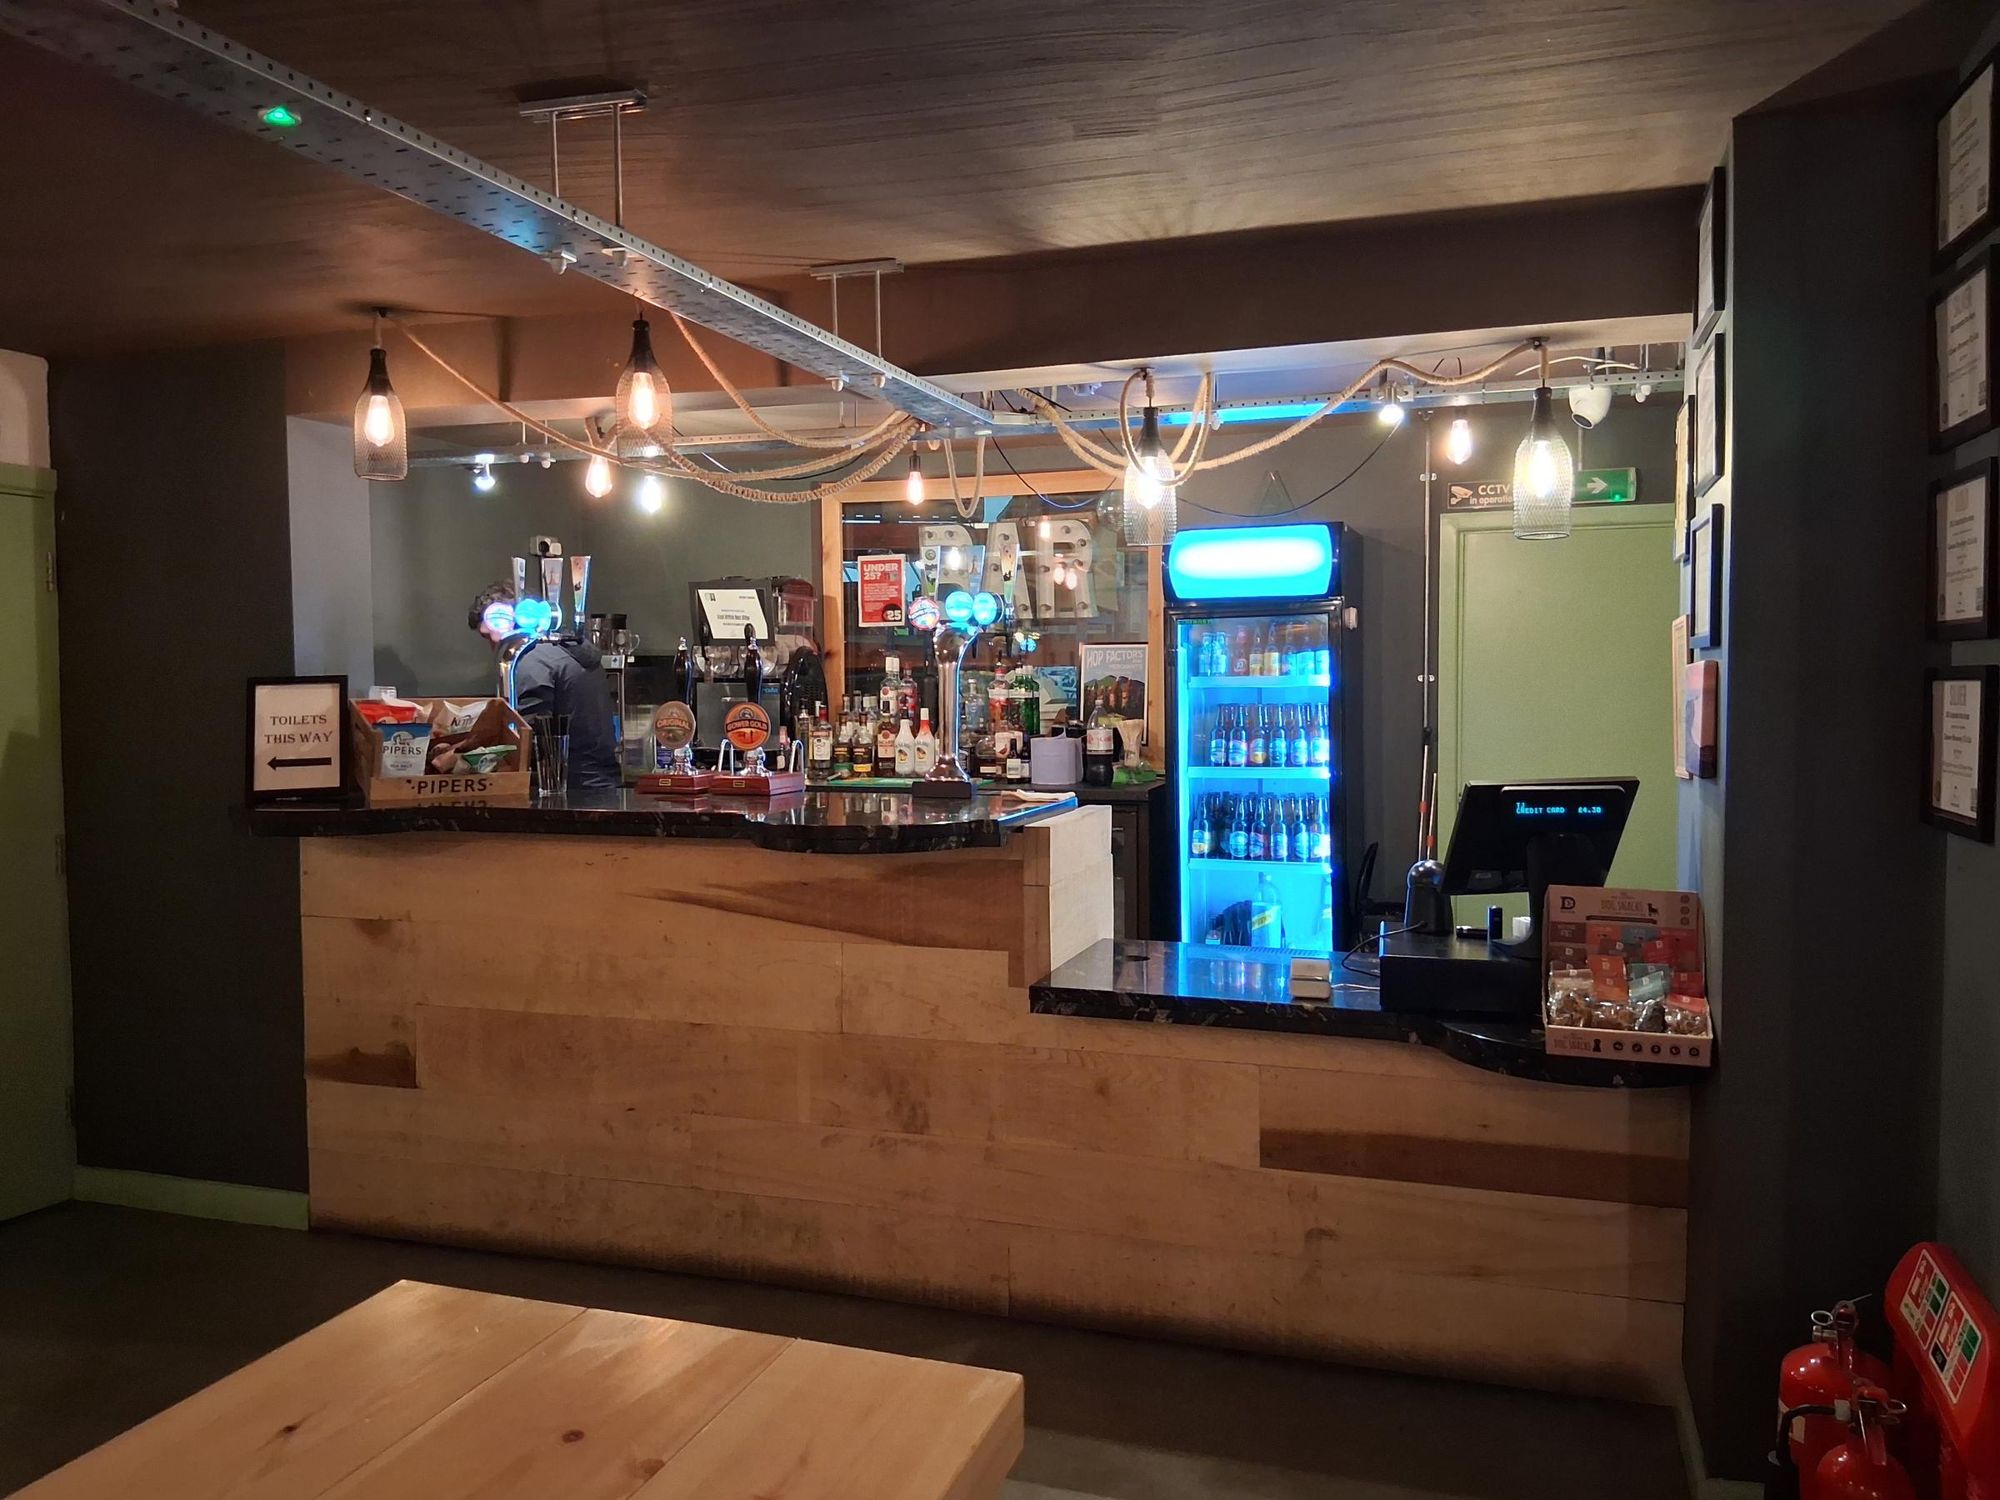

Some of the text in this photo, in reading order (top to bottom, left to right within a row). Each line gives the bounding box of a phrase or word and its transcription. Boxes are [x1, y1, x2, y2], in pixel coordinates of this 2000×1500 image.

[1478, 484, 1510, 495] CCTV
[1469, 496, 1477, 505] in
[863, 563, 898, 572] UNDER
[863, 572, 881, 580] 25?
[886, 609, 901, 620] 25
[1086, 650, 1104, 668] HOP
[1105, 650, 1144, 663] FACTORS
[269, 714, 327, 726] TOILETS
[656, 718, 691, 730] ORIGINAL
[727, 719, 768, 731] GOWER GOLD
[264, 731, 333, 744] THIS WAY
[382, 745, 422, 755] PIPERS
[417, 778, 487, 794] PIPERS
